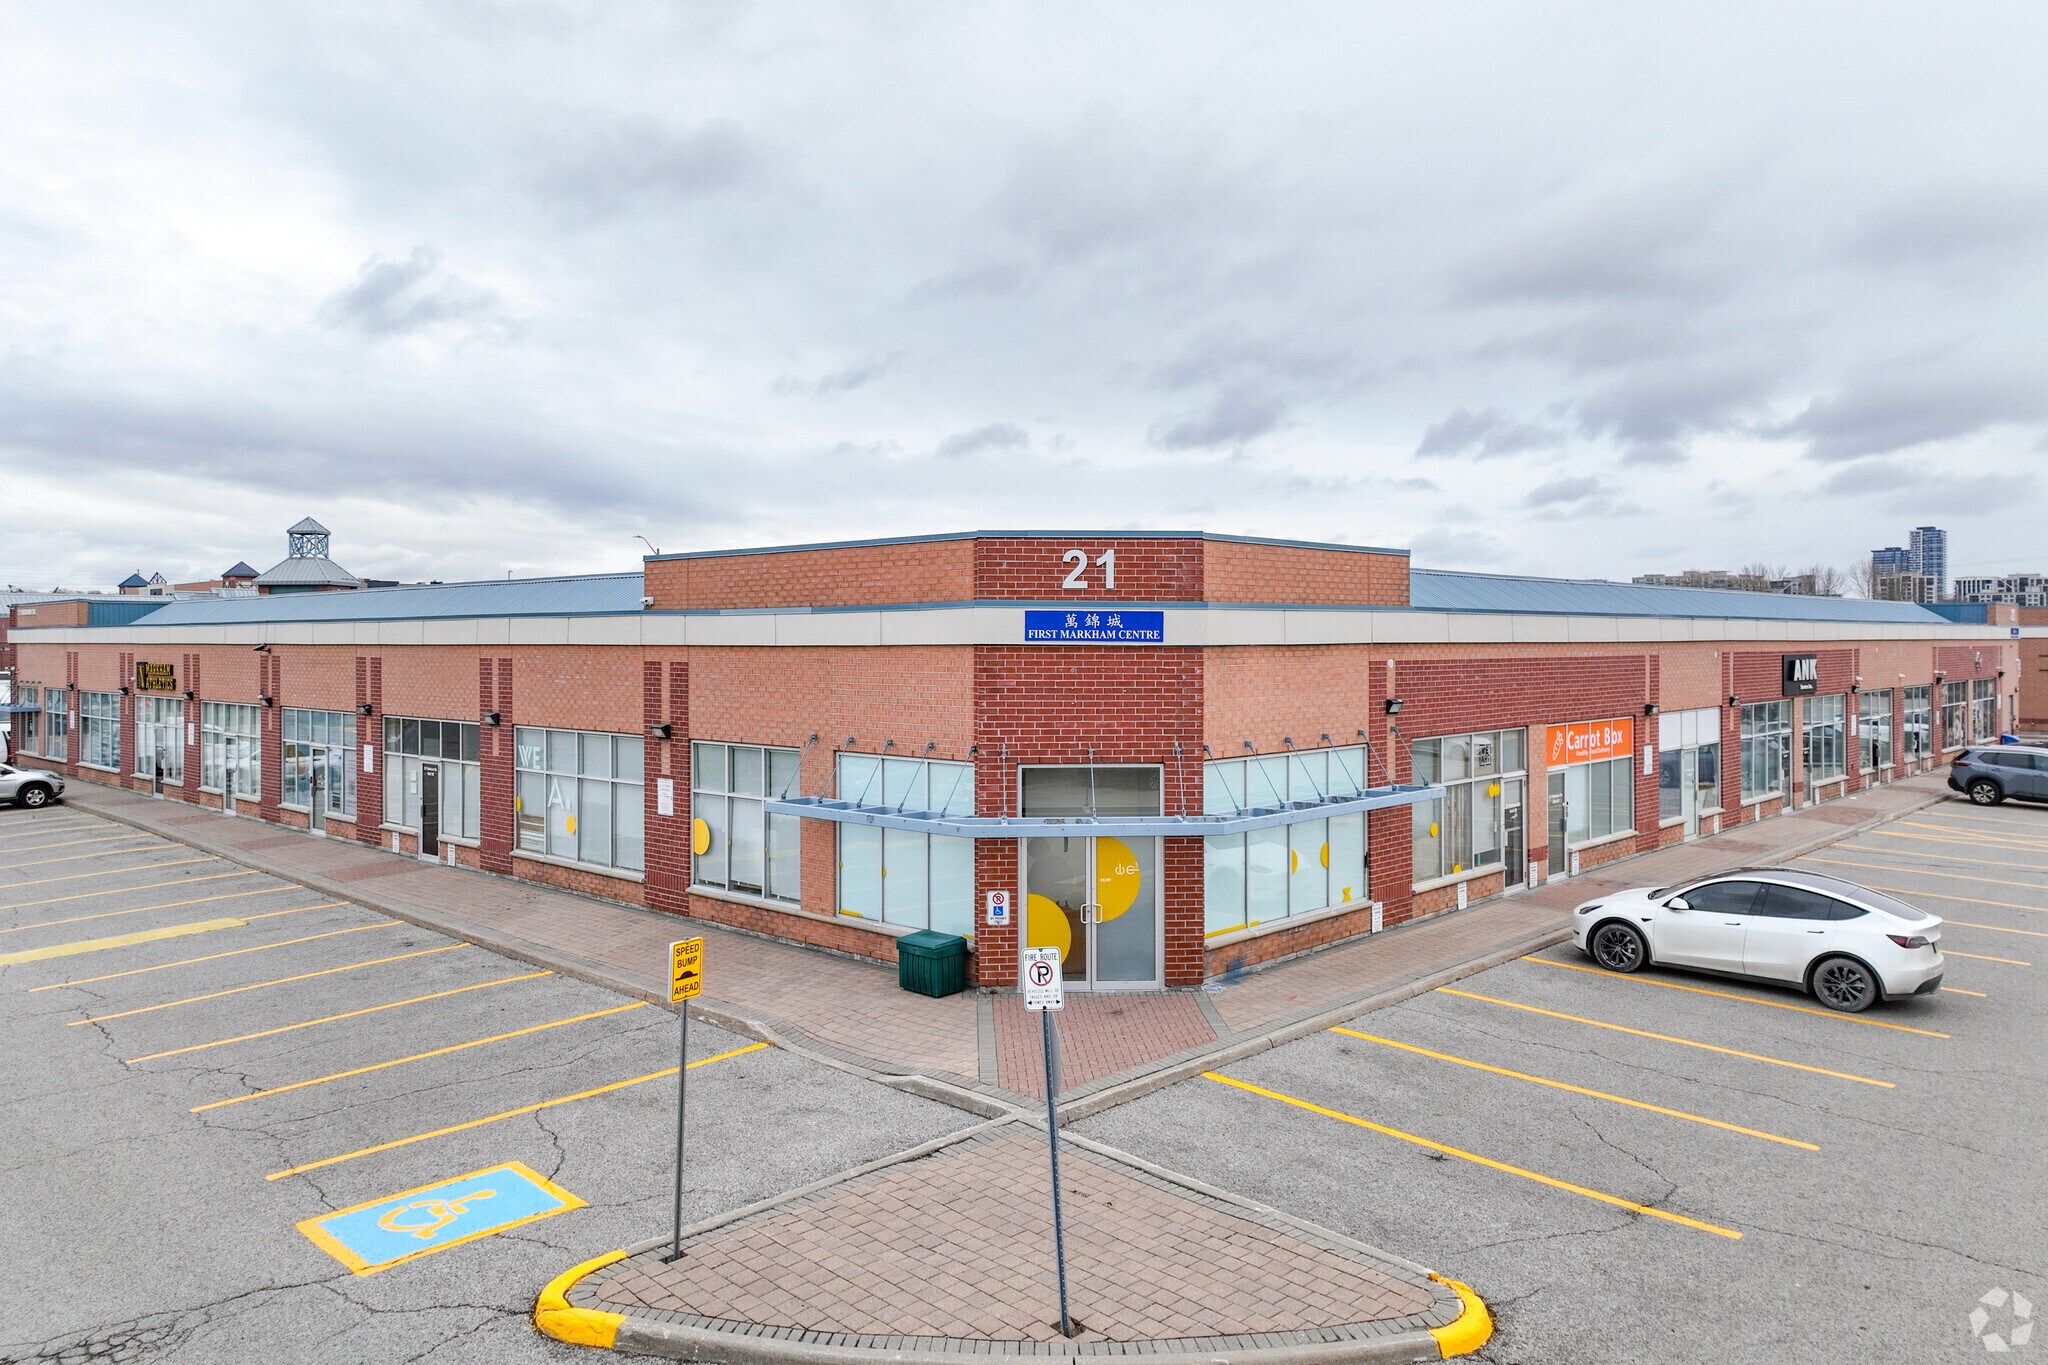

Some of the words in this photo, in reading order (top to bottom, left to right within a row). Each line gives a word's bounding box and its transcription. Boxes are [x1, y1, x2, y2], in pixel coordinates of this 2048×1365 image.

[1062, 549, 1115, 589] 21
[1028, 630, 1058, 639] FIRST
[1060, 630, 1116, 639] MARKHAM
[1118, 630, 1161, 639] CENTRE
[145, 663, 171, 675] MARKHAM
[1794, 659, 1818, 681] ANK
[145, 677, 173, 690] ATHLETICS
[1567, 730, 1601, 750] Carrot
[1604, 727, 1623, 746] Box
[675, 943, 700, 957] SPEED
[677, 955, 698, 968] BUMP
[1025, 953, 1037, 961] FIRE
[1040, 953, 1057, 961] ROUTE
[674, 981, 699, 996] AHEAD
